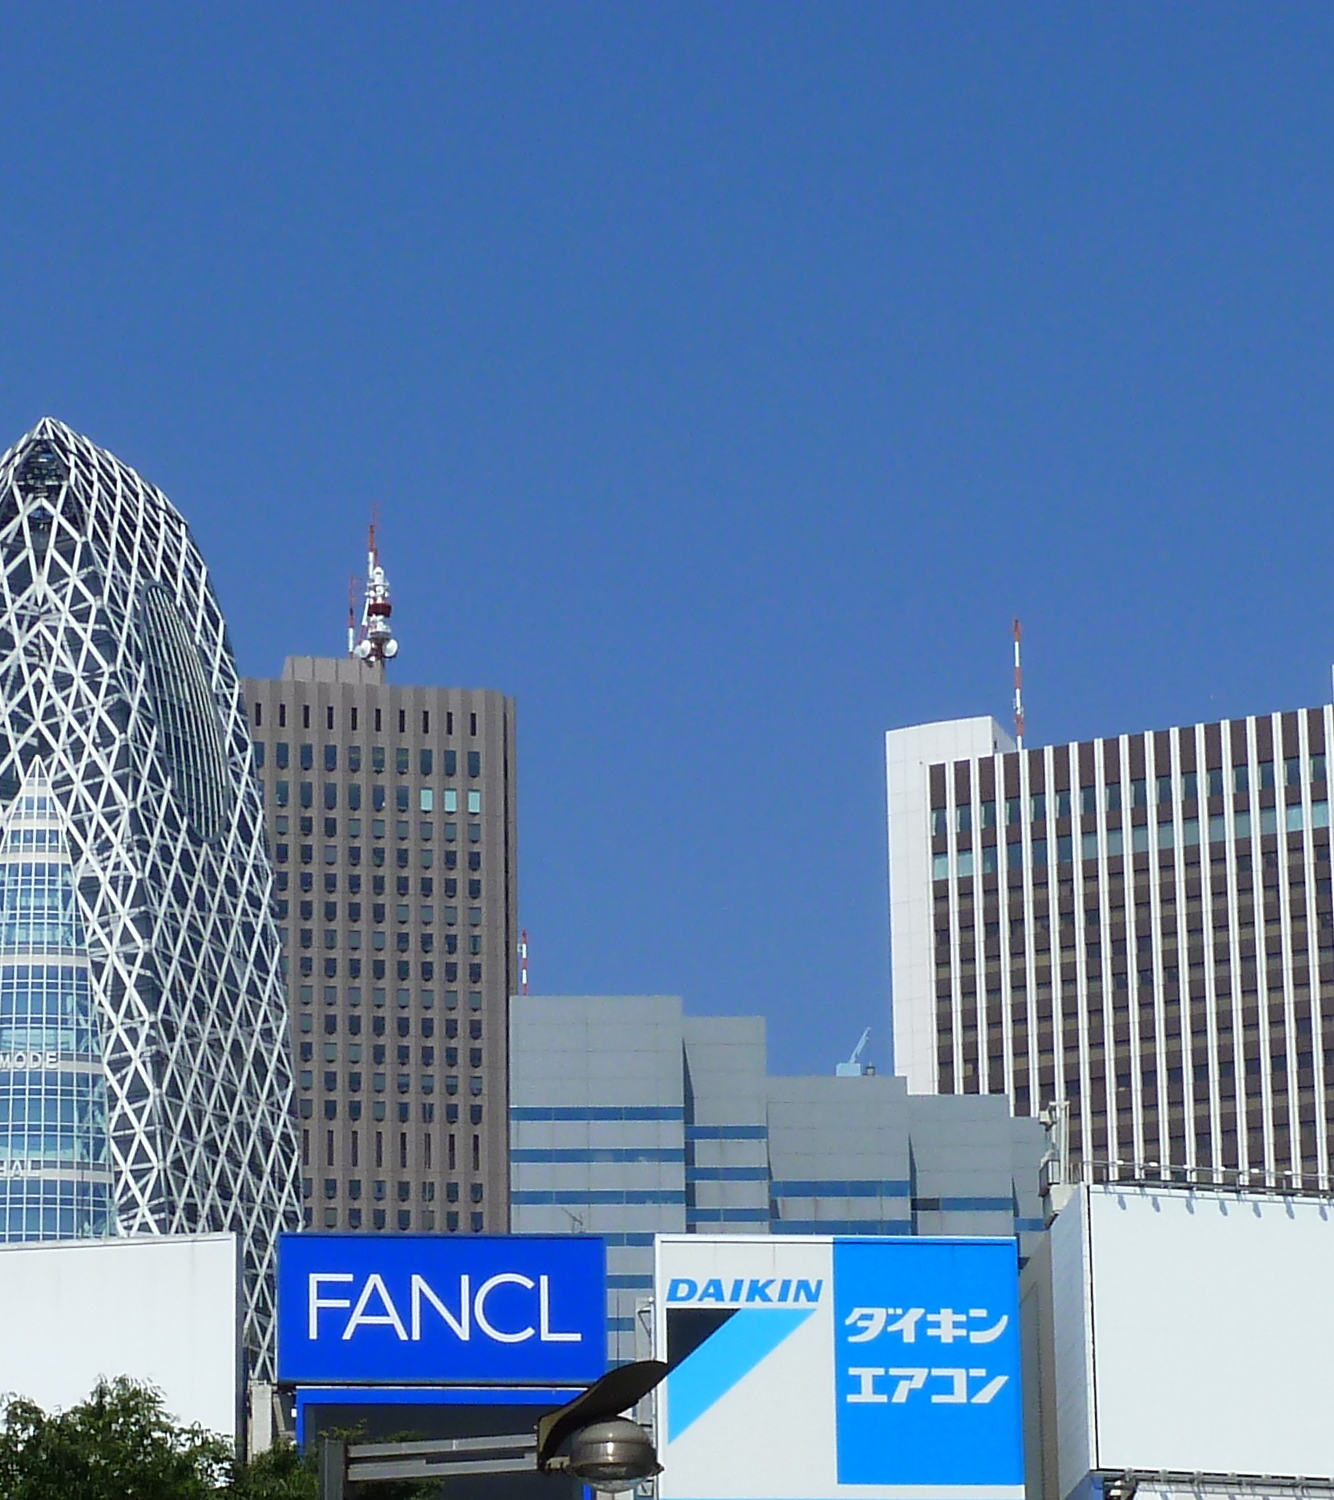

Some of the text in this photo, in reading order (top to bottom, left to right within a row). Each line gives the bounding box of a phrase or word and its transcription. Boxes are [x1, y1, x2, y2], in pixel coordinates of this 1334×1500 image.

[306, 1272, 583, 1344] FANCL
[665, 1278, 824, 1303] DAIKIN
[844, 1306, 1010, 1344] ダイキン
[845, 1366, 1011, 1404] エアコン
